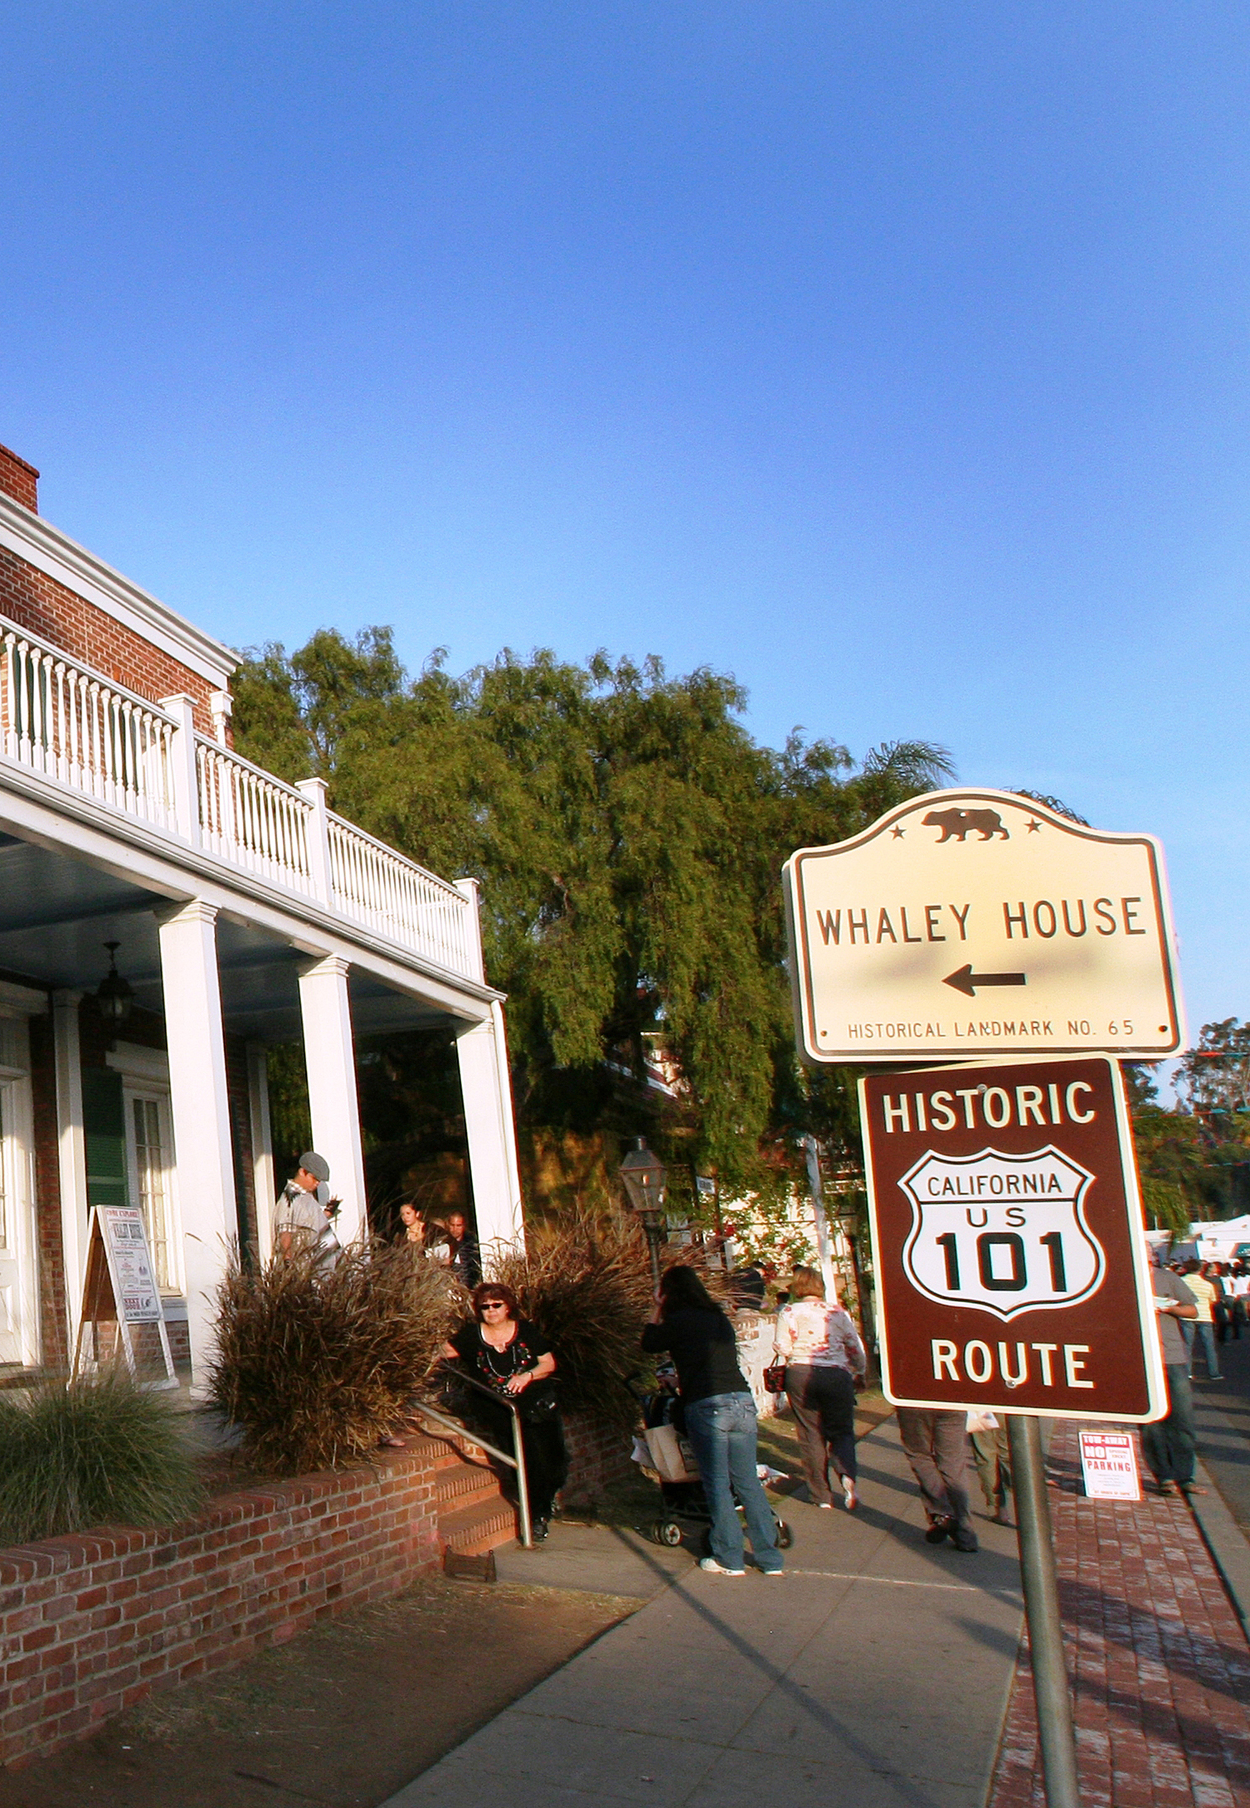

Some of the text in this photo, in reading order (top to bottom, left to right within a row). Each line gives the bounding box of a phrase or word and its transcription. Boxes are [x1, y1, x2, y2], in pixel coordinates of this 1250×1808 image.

[816, 896, 1146, 946] WHALEY HOUSE
[848, 1018, 1134, 1039] HISTORICAL LANDMARK NO. 65
[882, 1080, 1097, 1134] HISTORIC
[926, 1172, 1063, 1197] CALIFORNIA
[934, 1231, 1068, 1293] 101
[930, 1338, 1096, 1389] ROUTE
[1083, 1435, 1127, 1445] TOW-AWAY
[1084, 1446, 1106, 1458] NO
[1087, 1460, 1131, 1472] PARKING
